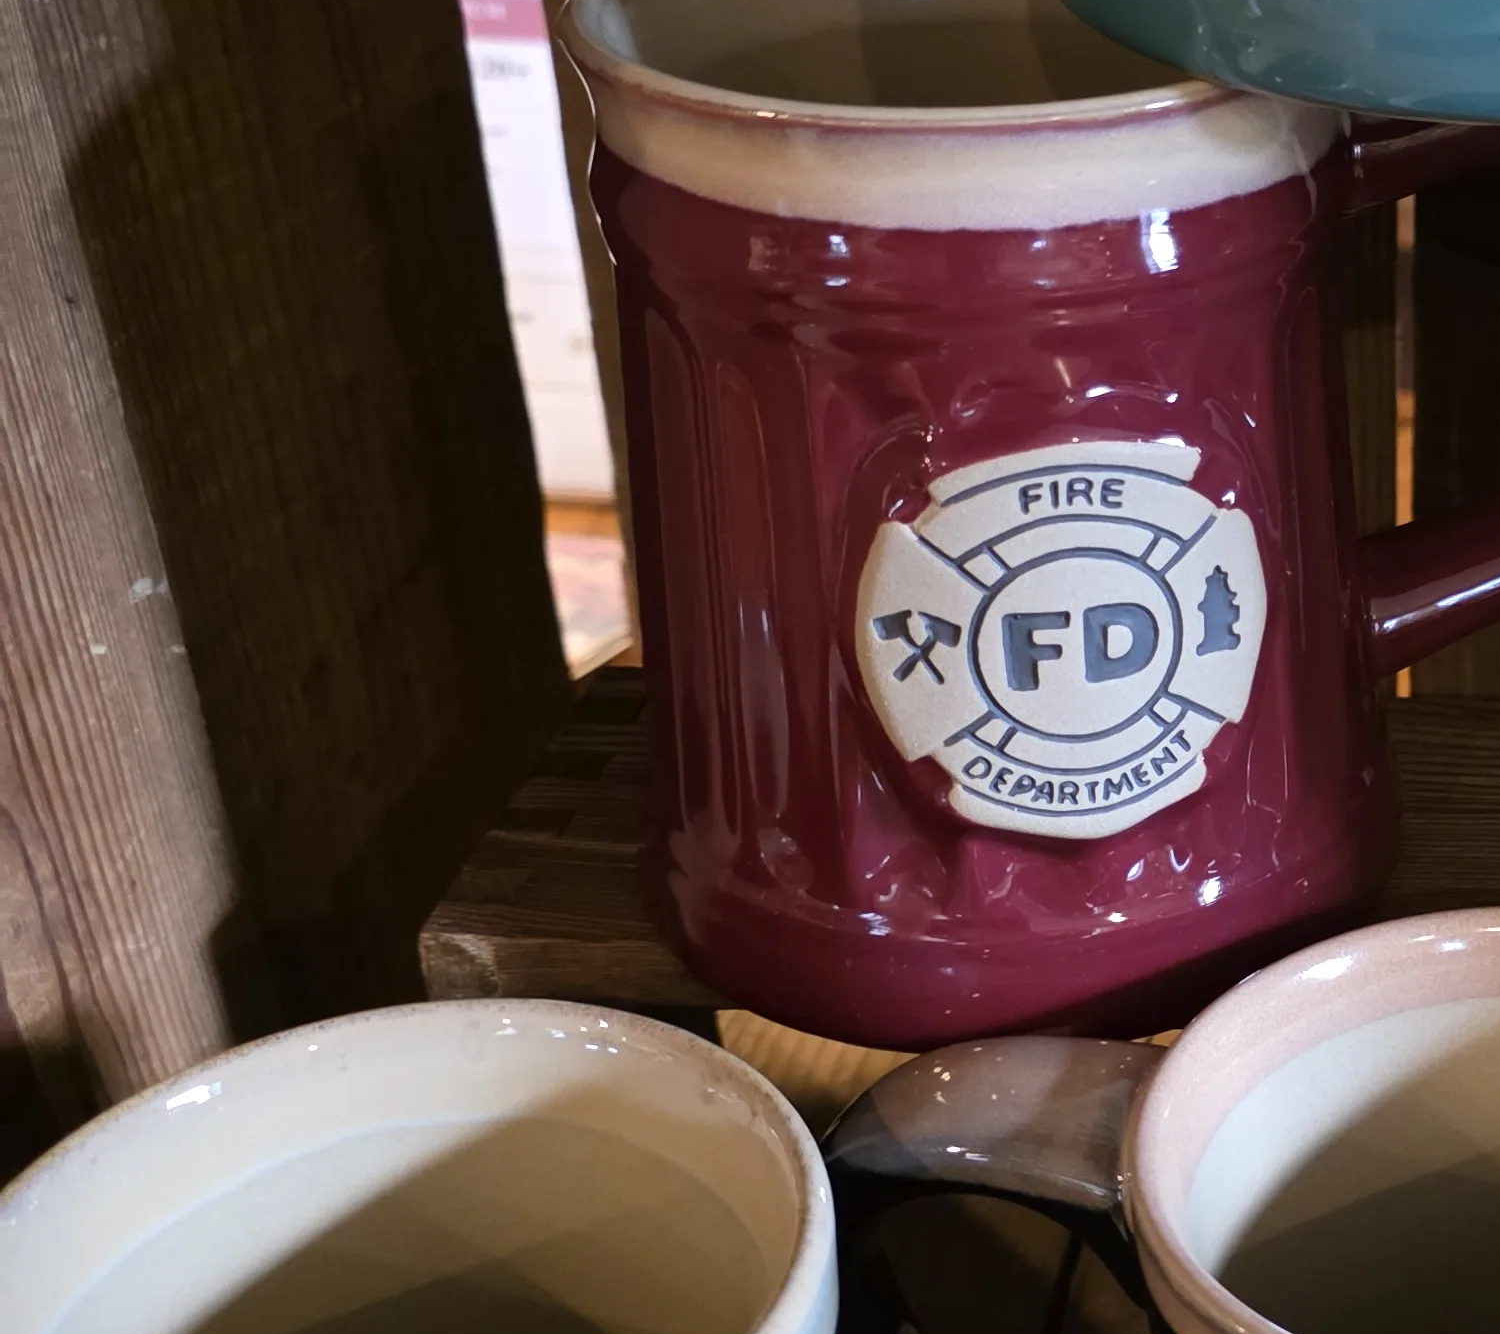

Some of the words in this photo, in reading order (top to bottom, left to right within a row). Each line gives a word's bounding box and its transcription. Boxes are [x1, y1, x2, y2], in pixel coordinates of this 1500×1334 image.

[1018, 477, 1126, 514] FIRE
[1002, 602, 1160, 692] FD
[961, 729, 1192, 805] DEPARTMENT
